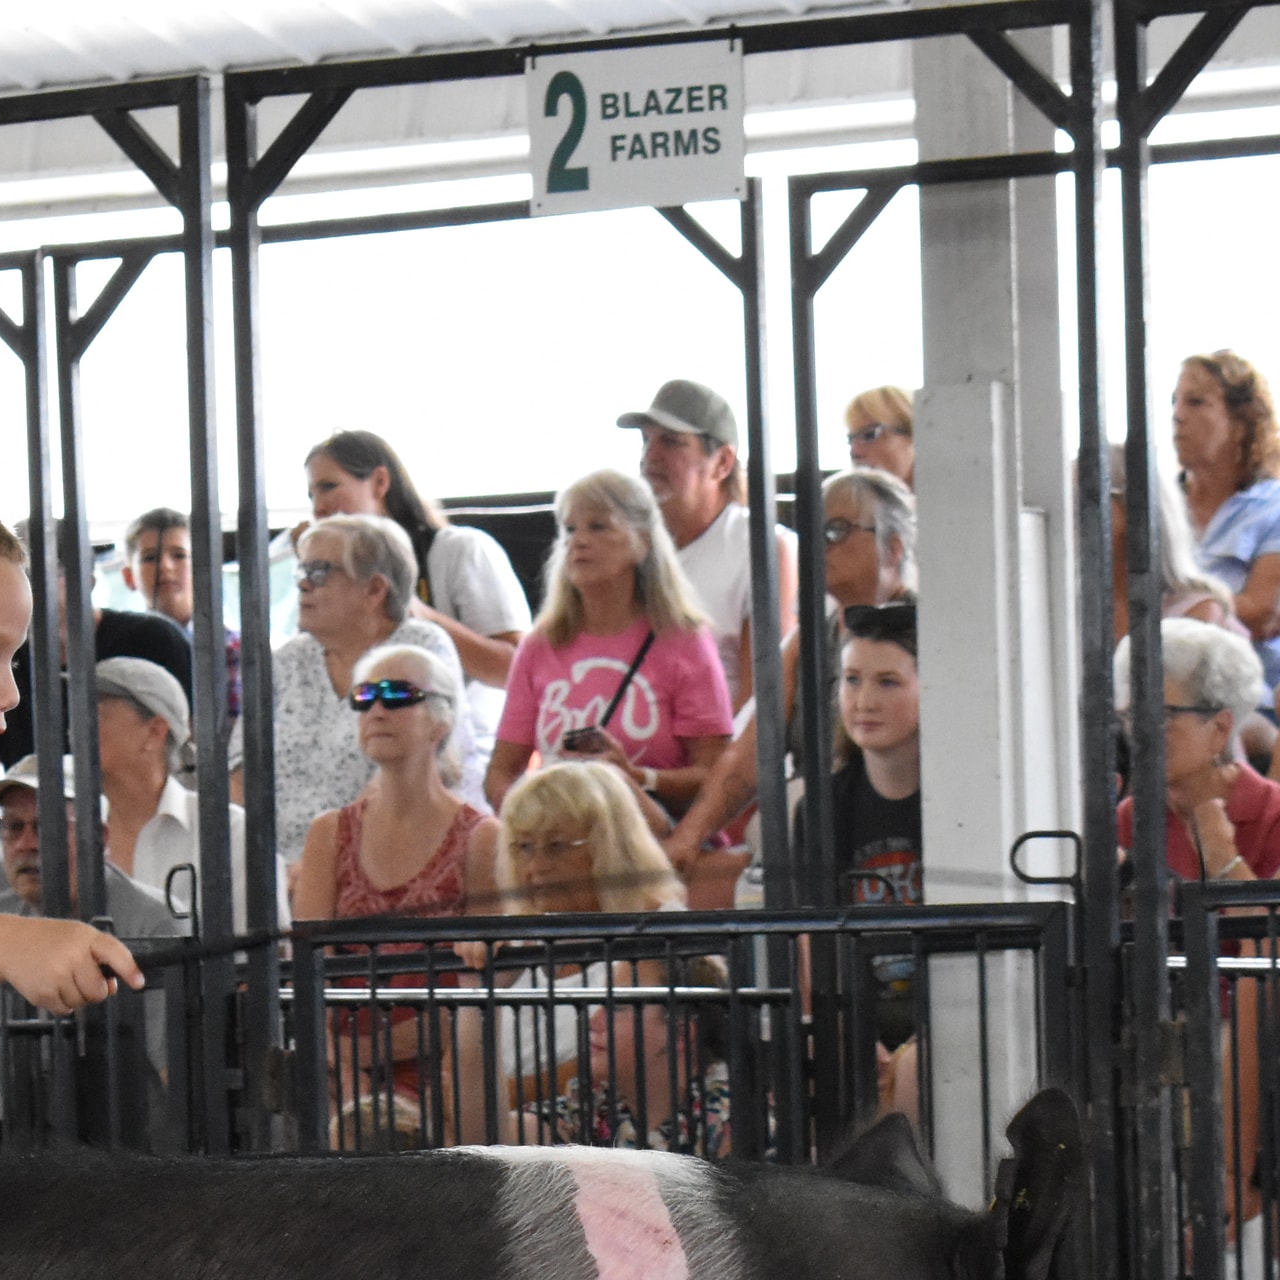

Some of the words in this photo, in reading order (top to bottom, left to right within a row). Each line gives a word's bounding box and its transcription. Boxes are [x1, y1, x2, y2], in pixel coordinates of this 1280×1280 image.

[600, 83, 729, 121] BLAZER
[544, 70, 590, 194] 2
[610, 126, 722, 162] FARMS
